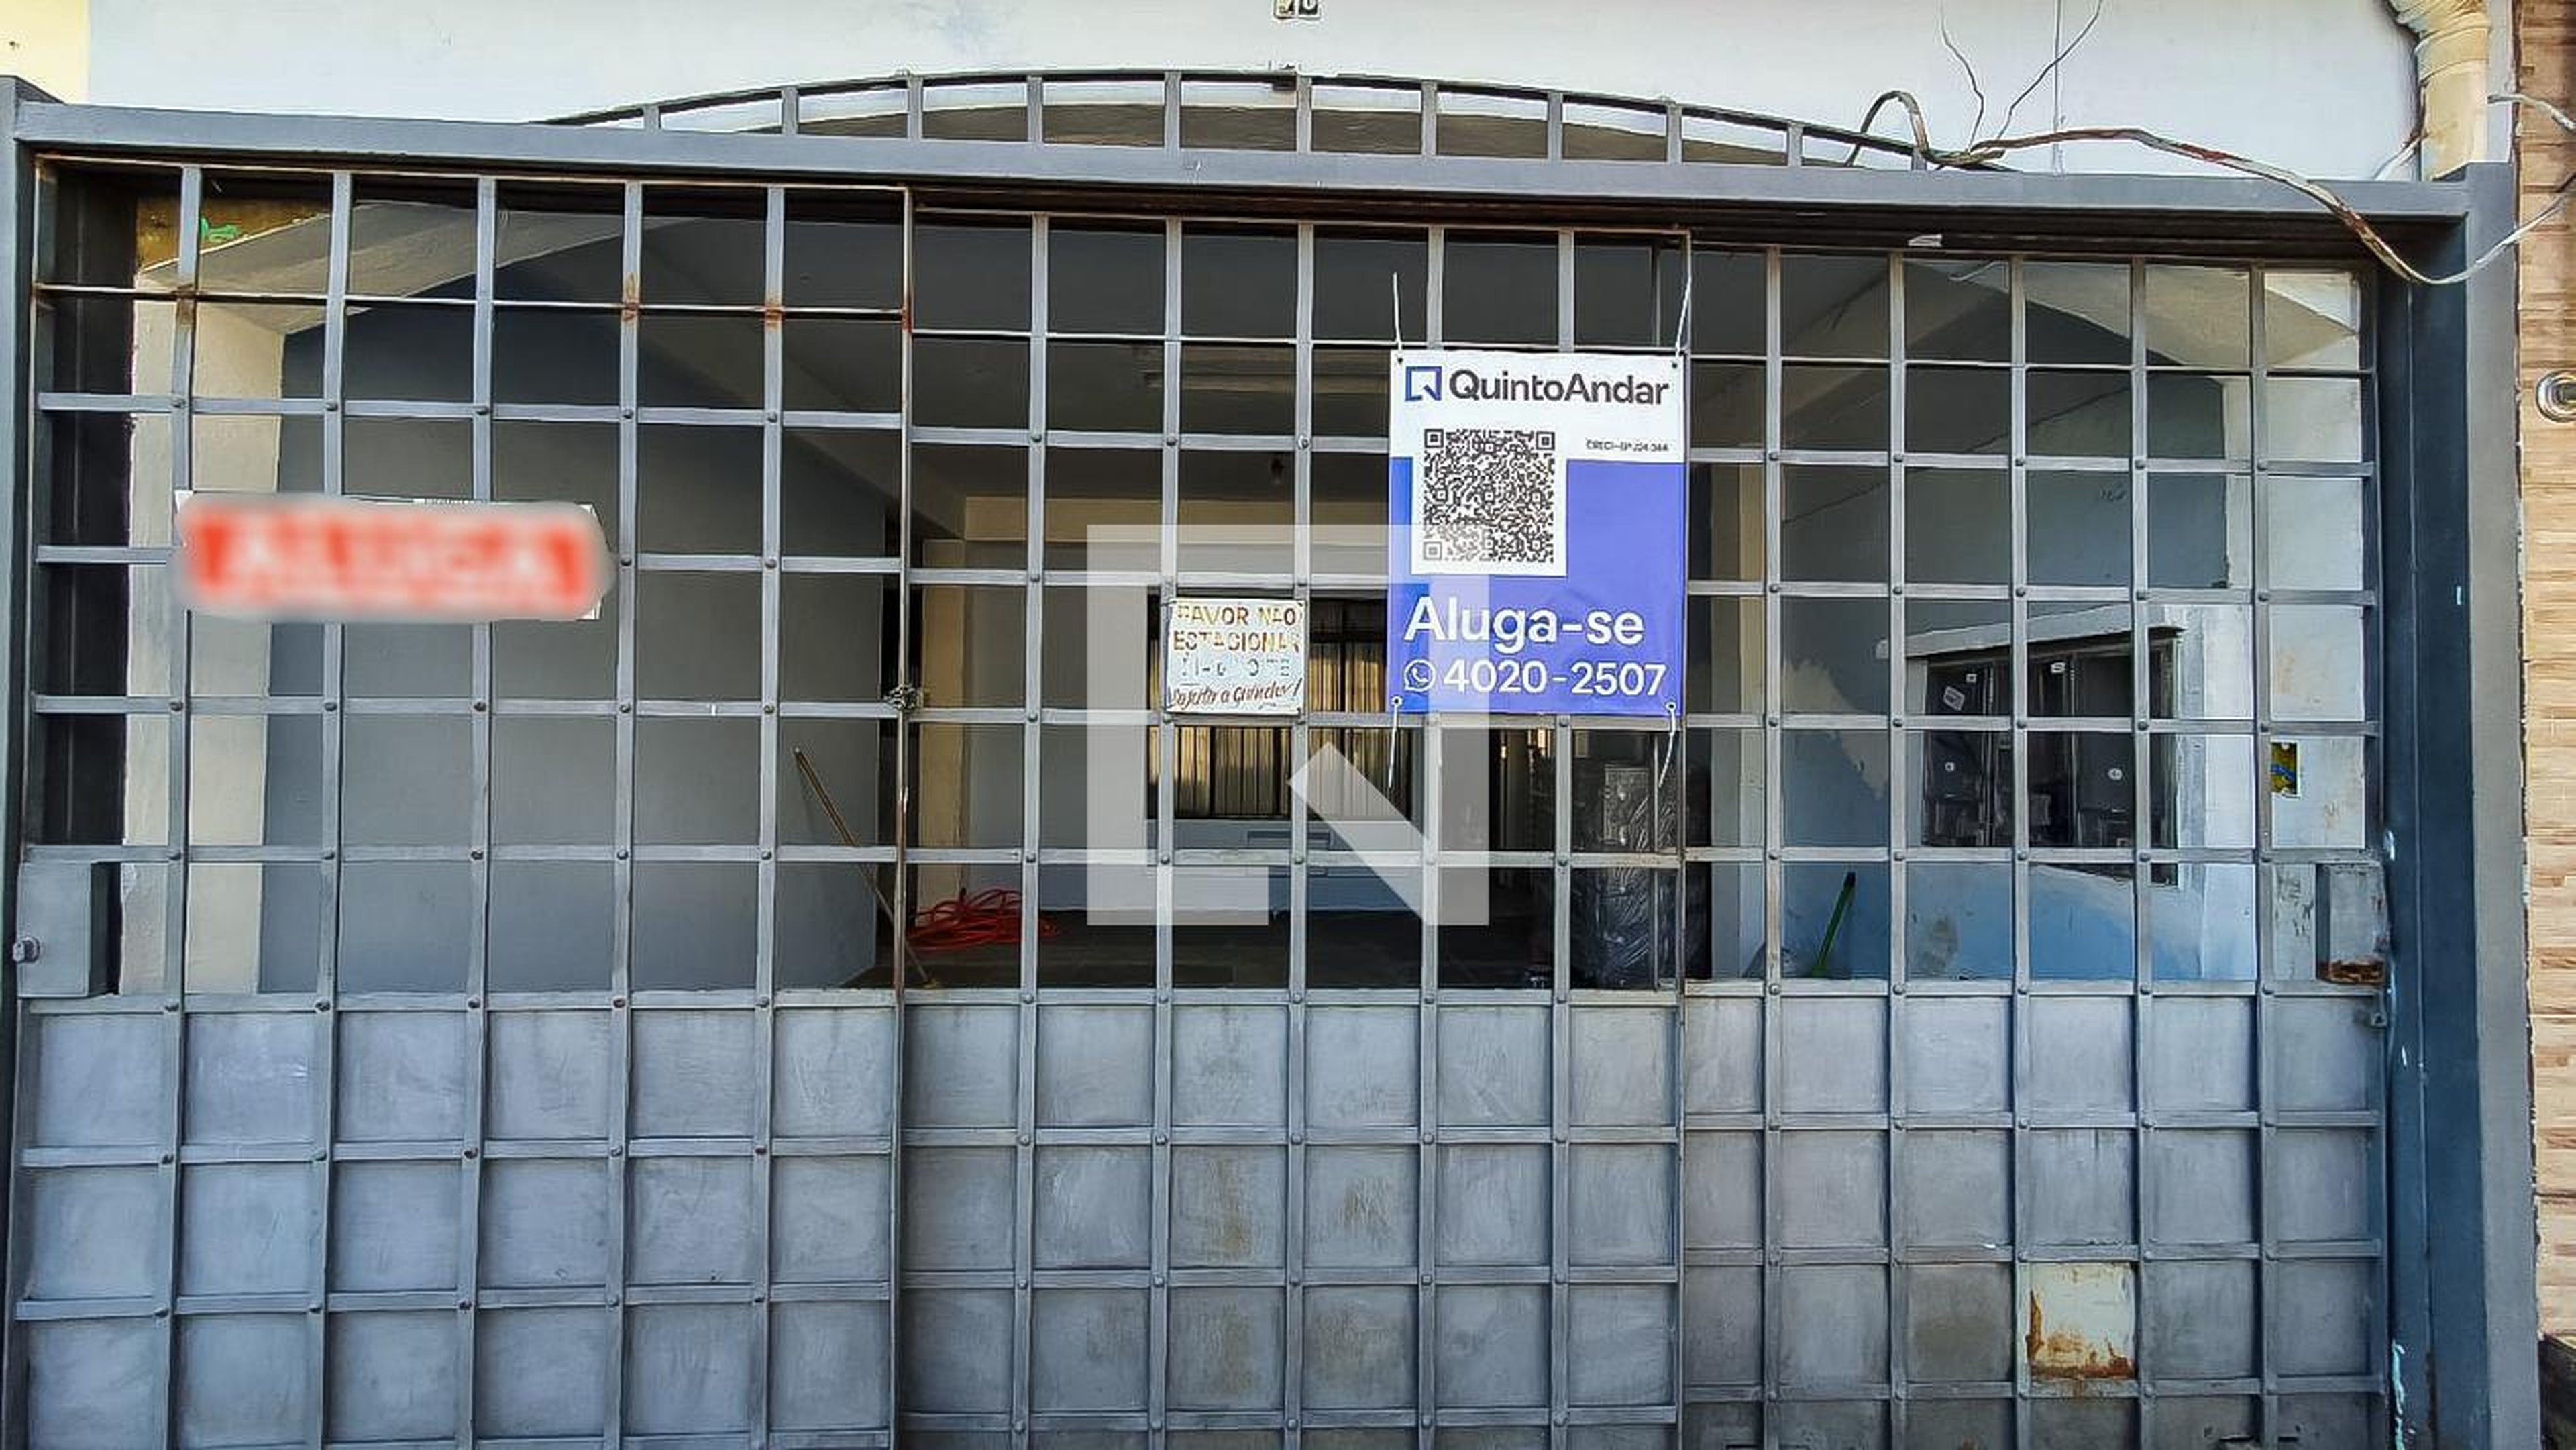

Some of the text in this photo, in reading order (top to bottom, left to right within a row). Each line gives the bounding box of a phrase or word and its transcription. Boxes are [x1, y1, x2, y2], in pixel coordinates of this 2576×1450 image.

[1448, 368, 1670, 405] QuintoAndar
[1404, 596, 1644, 654] Aluga-se
[1443, 660, 1666, 697] 4020-2507
